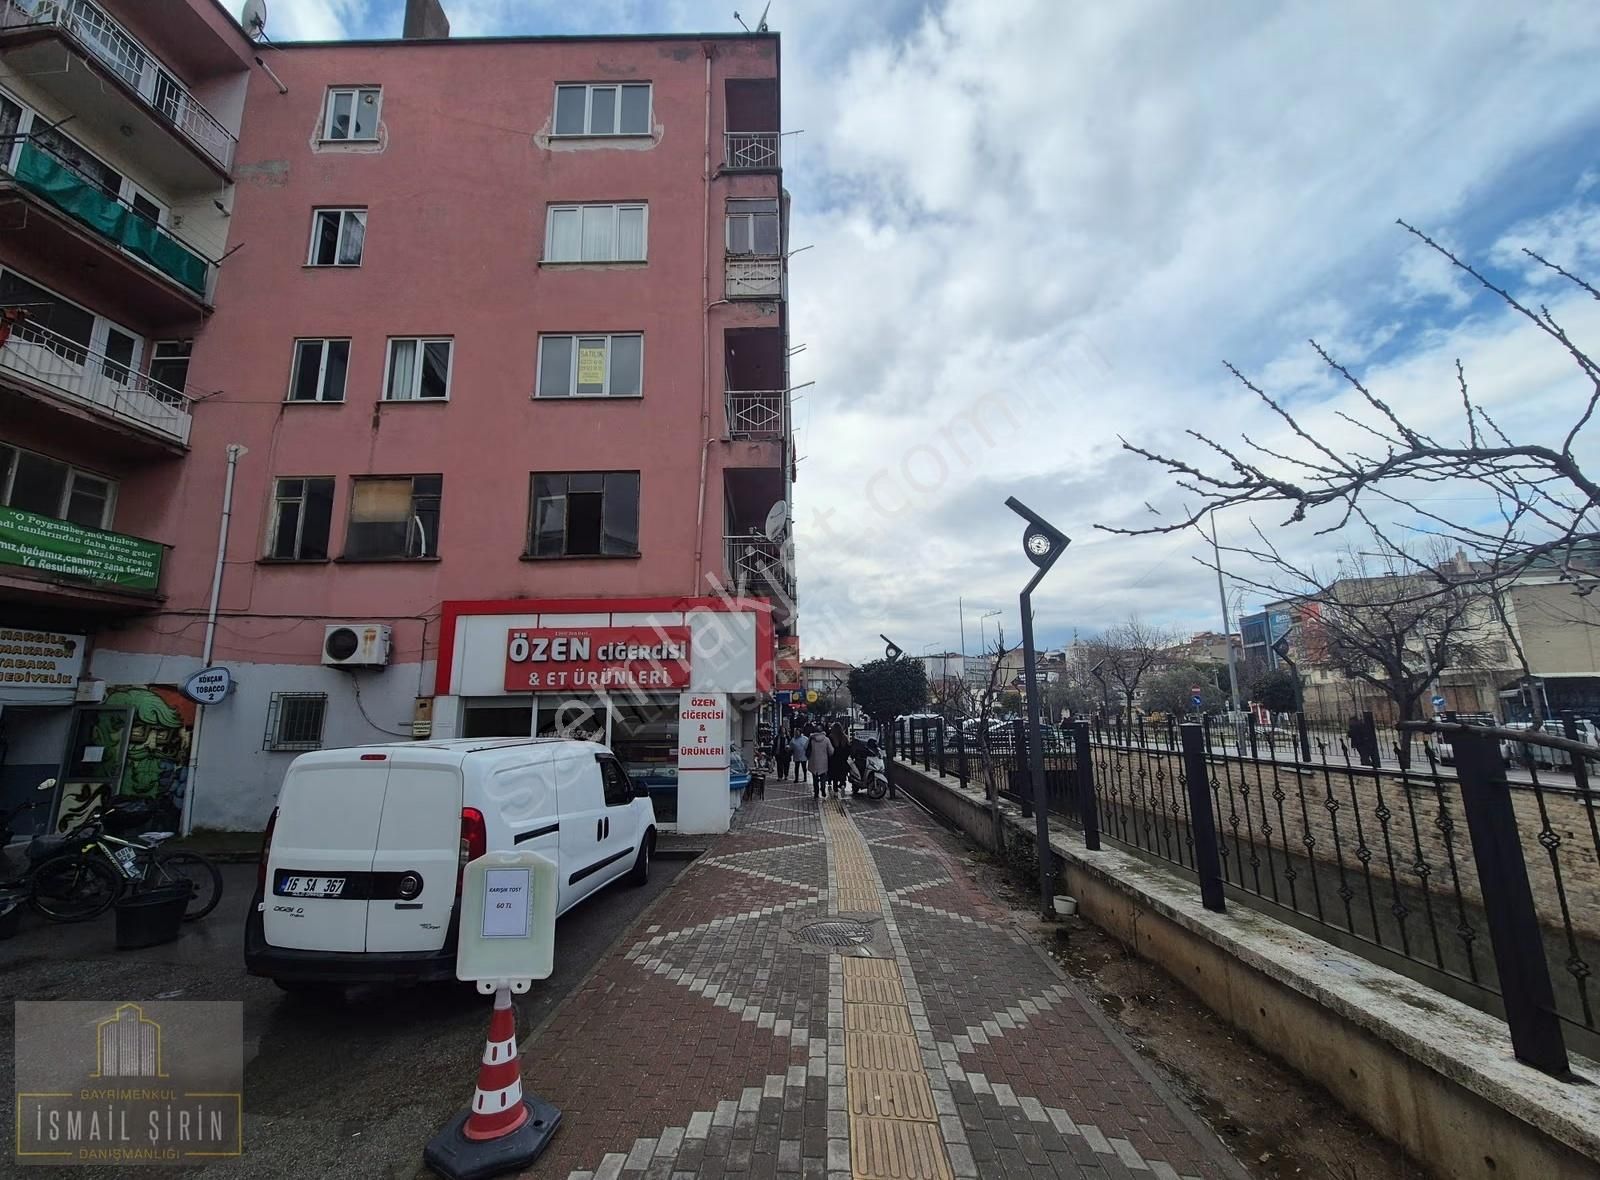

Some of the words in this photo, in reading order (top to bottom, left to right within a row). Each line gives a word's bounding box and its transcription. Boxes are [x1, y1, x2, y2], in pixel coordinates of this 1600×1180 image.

[23, 556, 35, 567] Ya
[104, 562, 124, 572] sana
[509, 633, 591, 662] ÖZEN
[597, 642, 686, 661] CİĞERCİSİ
[528, 672, 540, 686] &
[546, 671, 568, 686] ET
[573, 668, 668, 686] ÜRÜNLERİ
[195, 685, 225, 694] TOBACCO
[691, 697, 716, 707] ÖZEN
[681, 710, 724, 720] CİĞERCİSİ
[699, 724, 706, 732] &
[681, 746, 724, 756] ÜRÜNLERİ
[286, 878, 300, 891] 16
[304, 878, 318, 892] SA
[323, 879, 345, 893] 367
